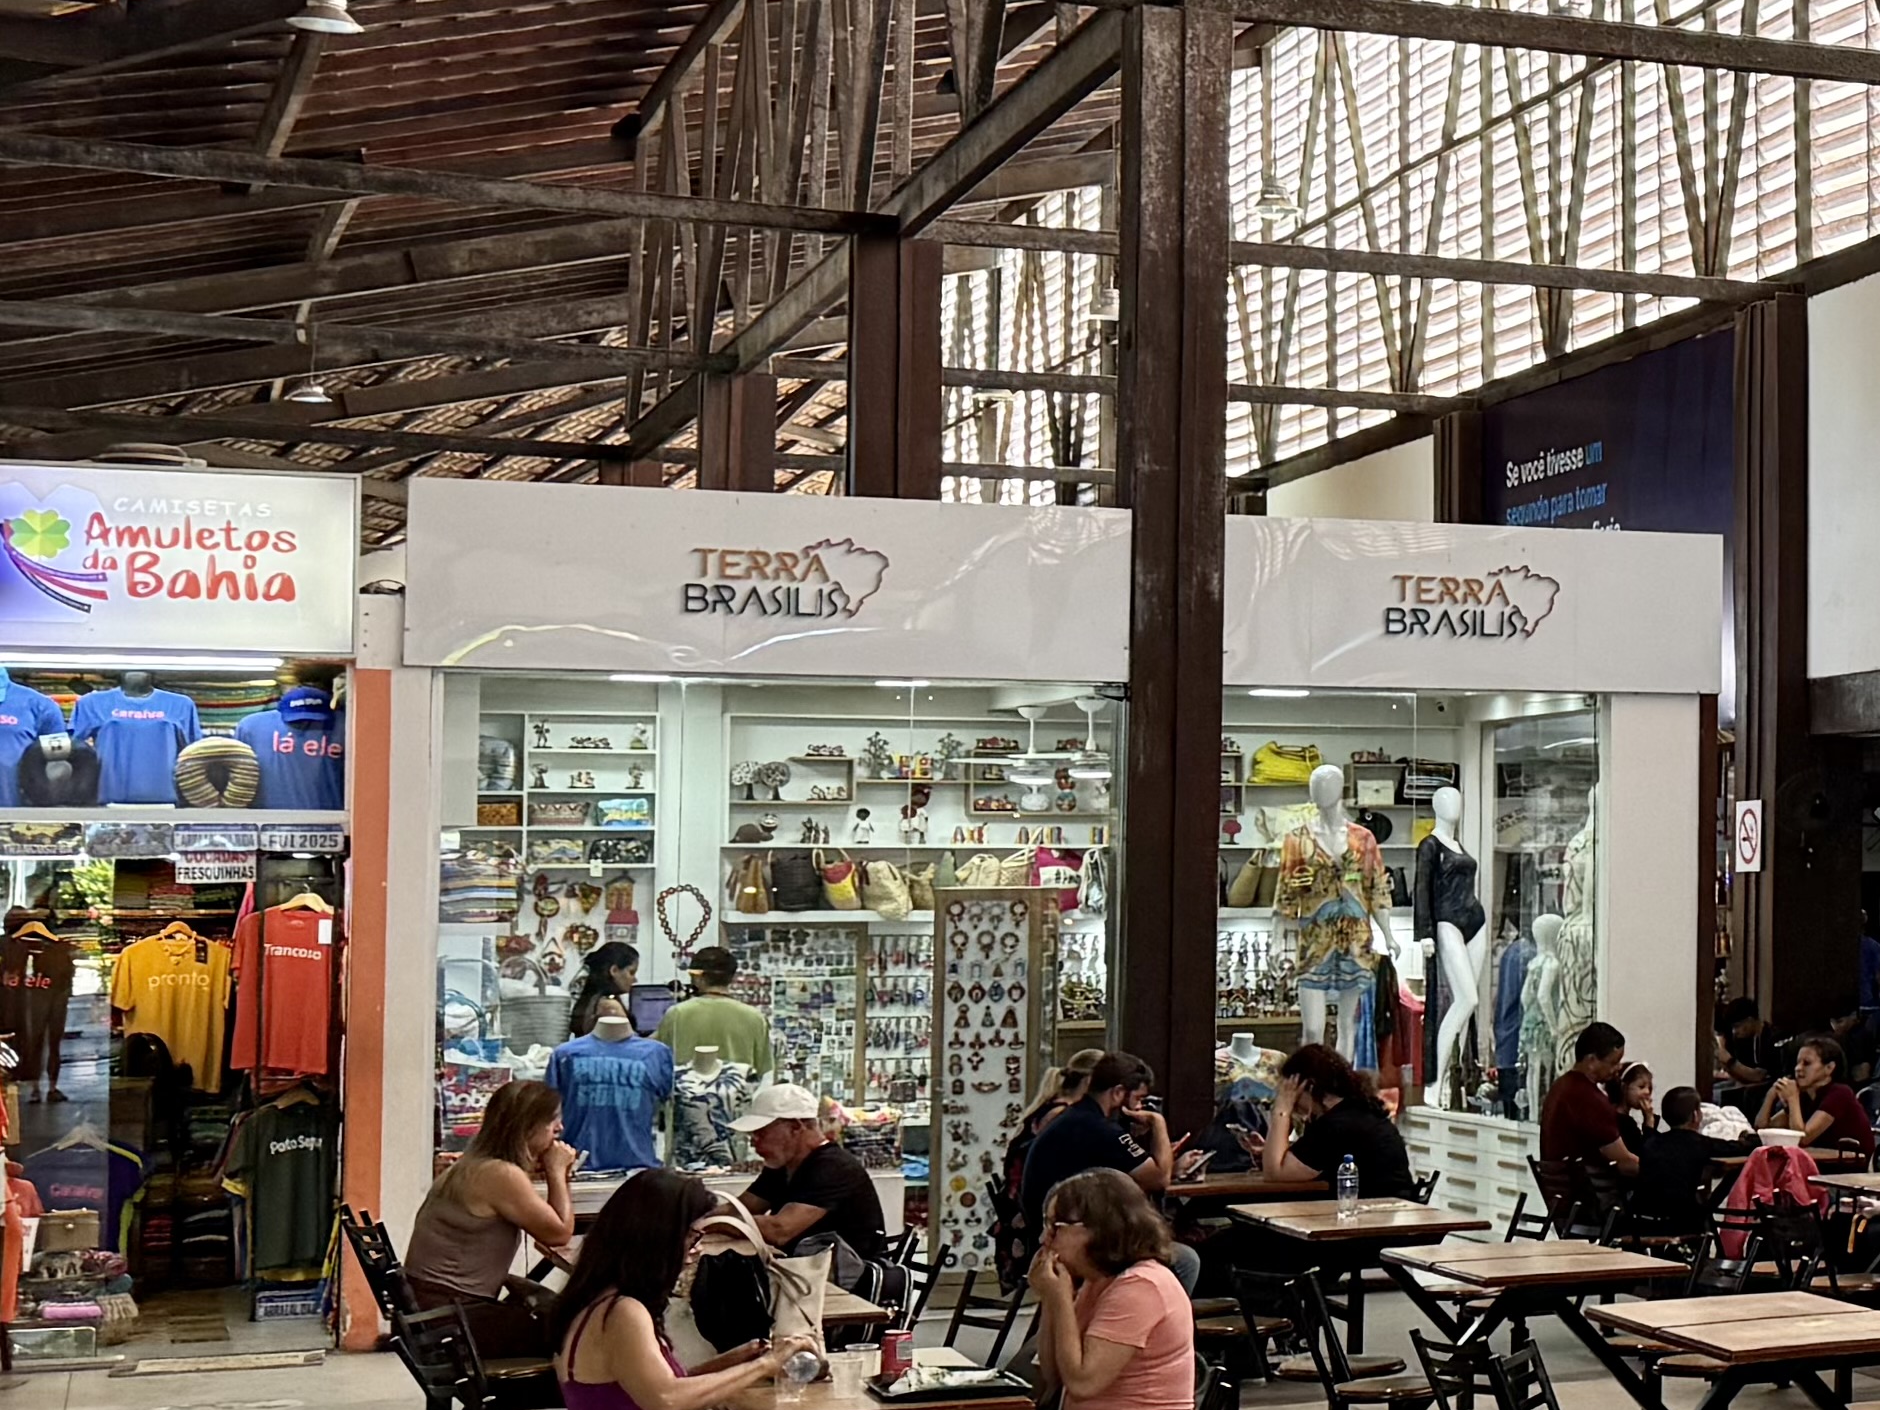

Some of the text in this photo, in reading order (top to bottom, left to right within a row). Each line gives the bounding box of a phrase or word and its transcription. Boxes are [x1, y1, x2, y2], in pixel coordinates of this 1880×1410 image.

[1506, 441, 1602, 488] Se você tivesse um
[114, 497, 272, 516] CAMISETAS
[1551, 491, 1574, 524] para
[1576, 483, 1608, 511] tomar
[84, 511, 298, 553] Amuletos
[82, 548, 297, 602] da Bahia
[691, 548, 830, 582] TERRA
[683, 583, 839, 618] BRASILIS
[1392, 575, 1510, 606] TERRA
[1385, 608, 1518, 638] BRASILIS
[273, 730, 343, 758] lá ele
[299, 834, 339, 848] 2025
[178, 866, 254, 880] FRESQUINHAS
[264, 943, 322, 960] Trancoso
[148, 970, 210, 992] pronto
